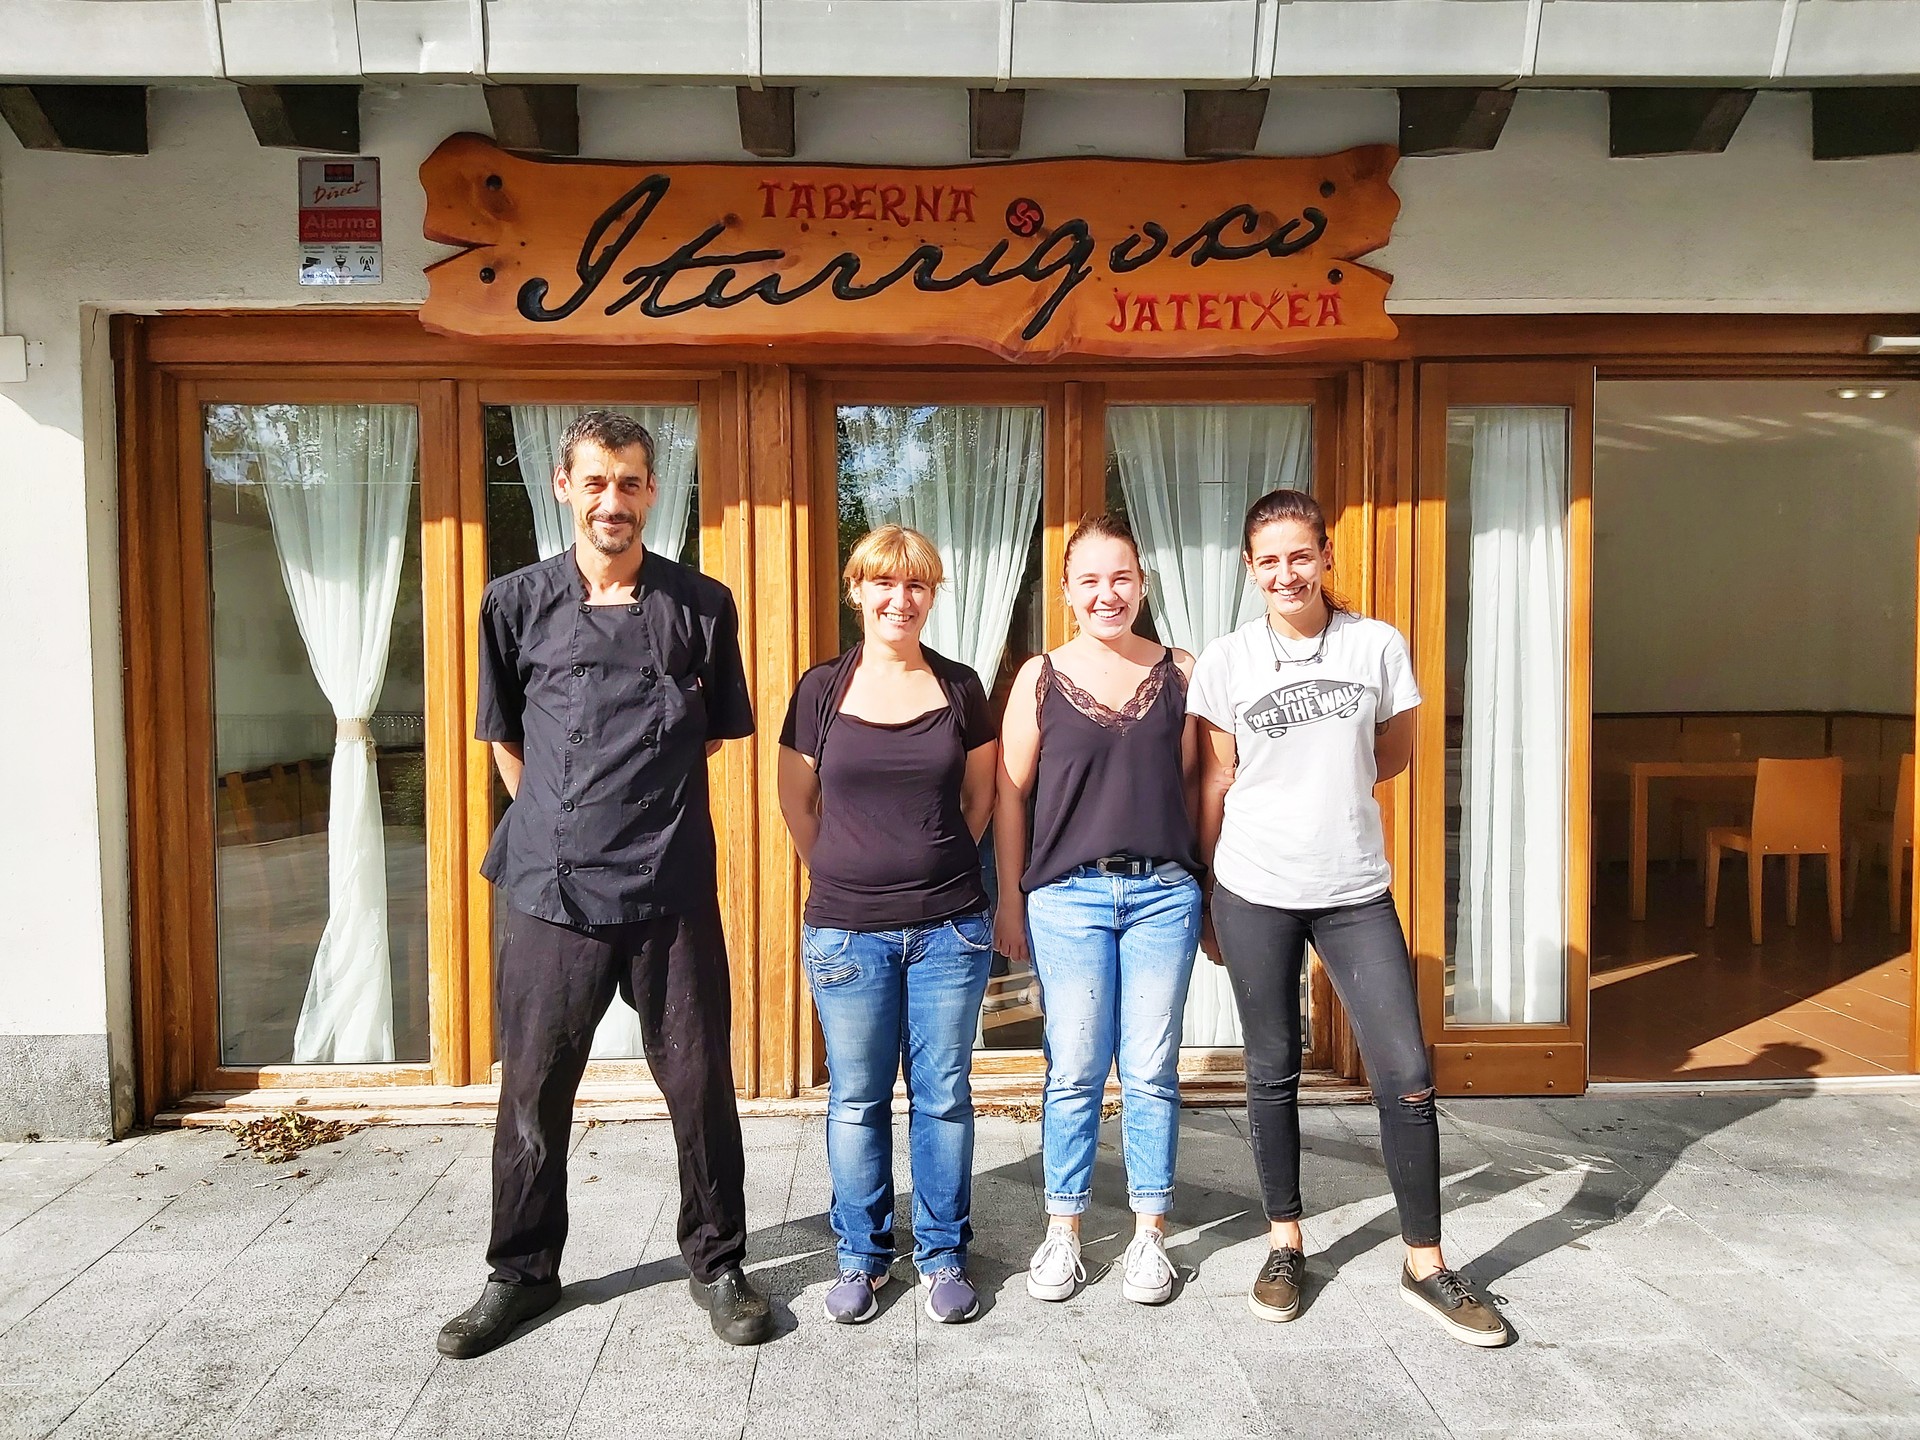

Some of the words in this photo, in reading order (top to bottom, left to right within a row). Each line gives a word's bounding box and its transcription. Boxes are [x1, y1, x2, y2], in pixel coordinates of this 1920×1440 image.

[313, 180, 366, 204] Direct
[757, 179, 979, 228] TABERNA
[305, 213, 377, 229] Alarma
[1105, 287, 1346, 333] JATETXEA
[1269, 681, 1320, 706] VANS
[1280, 697, 1318, 722] THE
